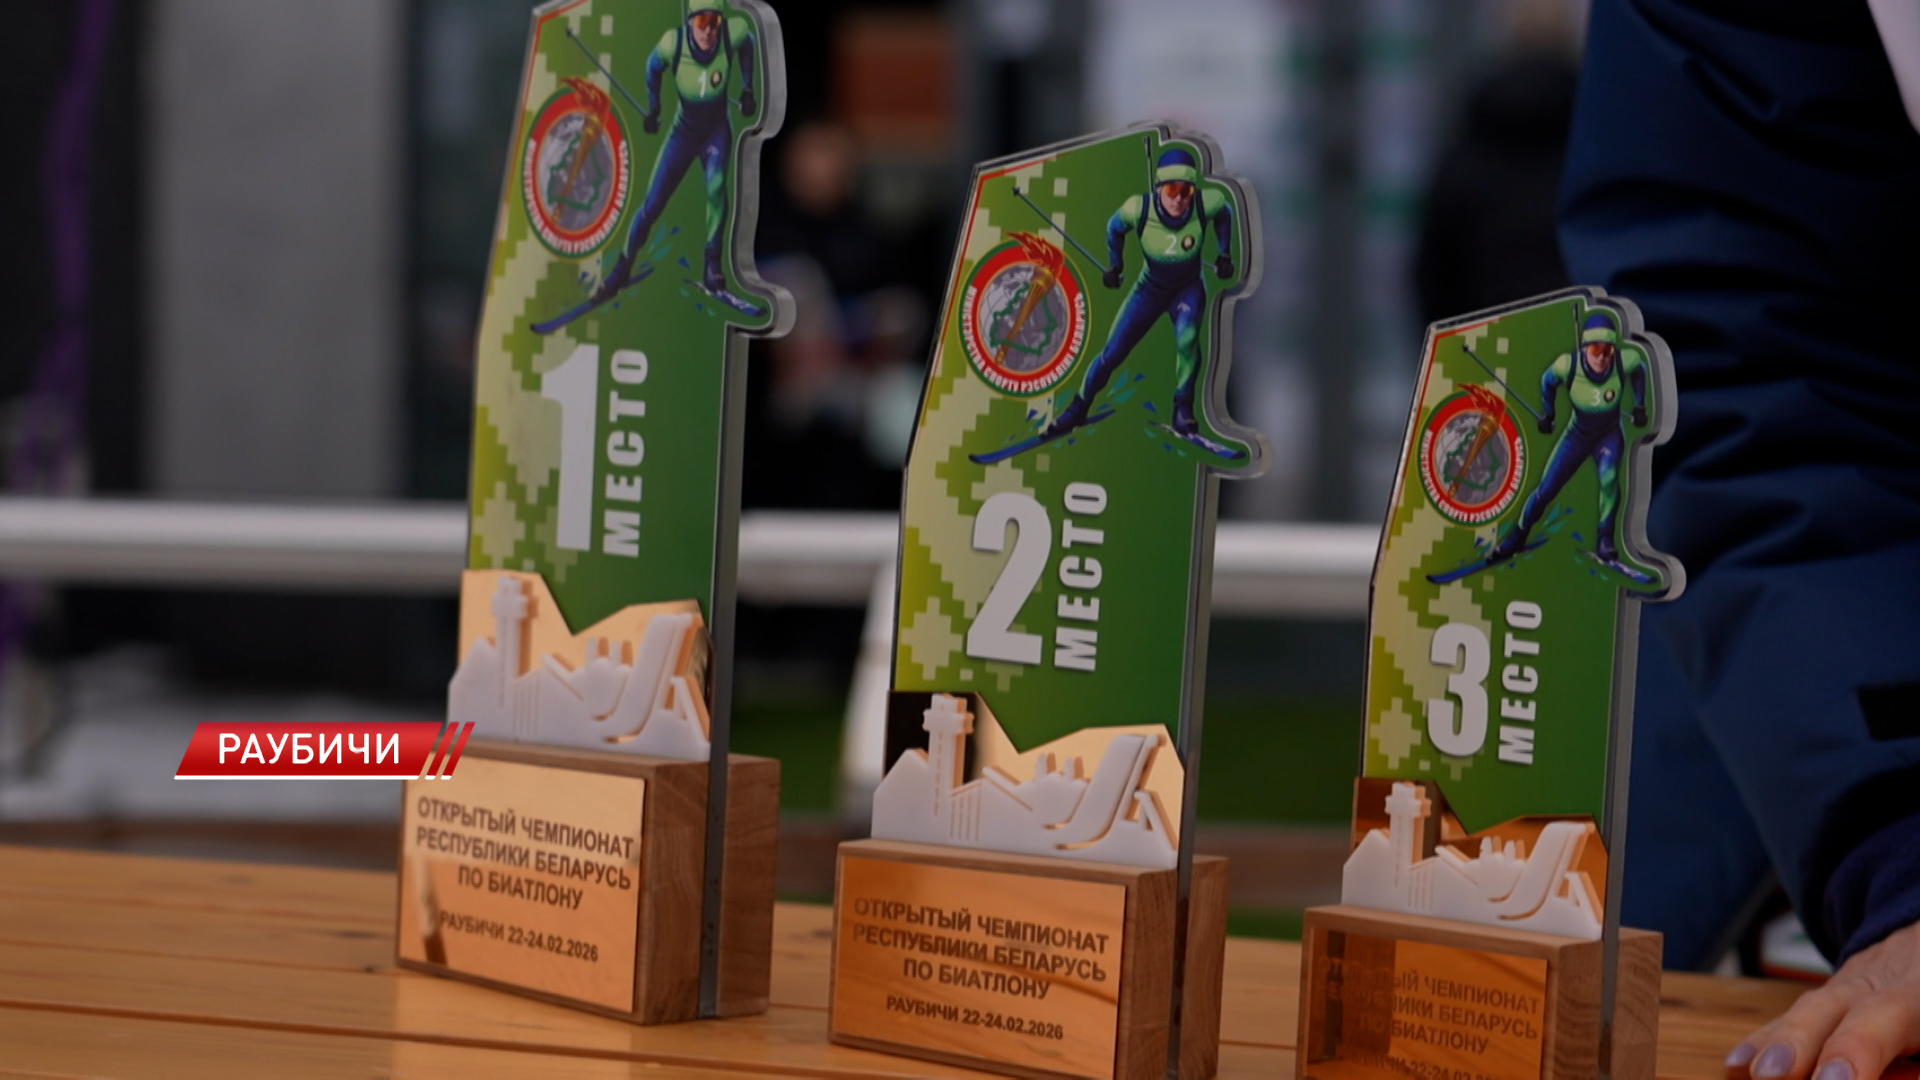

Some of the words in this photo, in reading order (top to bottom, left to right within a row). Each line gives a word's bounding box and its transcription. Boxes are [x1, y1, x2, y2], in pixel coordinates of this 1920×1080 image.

[698, 70, 707, 98] 1
[1164, 235, 1177, 255] 2
[1590, 389, 1600, 406] 3
[541, 343, 599, 551] 1
[603, 349, 648, 557] МЕСТО
[966, 491, 1052, 665] 2
[1054, 481, 1107, 672] МЕСТО
[1427, 623, 1491, 757] 3
[1498, 600, 1542, 765] МЕСТО
[417, 796, 516, 835] ОТКРЫТЫЙ
[521, 817, 634, 859] ЧЕМПИОНАТ
[417, 826, 530, 869] РЕСПУБЛИКИ
[535, 850, 631, 890] БЕЛАРУСЬ
[458, 865, 483, 888] ПО
[488, 872, 583, 910] БИАТЛОНУ
[440, 911, 504, 940] РАУБИЧИ
[508, 925, 598, 962] 22-24.02.2026
[854, 898, 971, 932] ОТКРЫТЫЙ
[977, 914, 1109, 954] ЧЕМПИОНАТ
[853, 923, 987, 962] РЕСПУБЛИКИ
[994, 945, 1106, 982] БЕЛАРУСЬ
[903, 958, 933, 980] ПО
[938, 964, 1050, 1000] БИАТЛОНУ
[1424, 975, 1540, 1014] ЧЕМПИОНАТ
[886, 995, 958, 1021] РАУБИЧИ
[962, 1008, 1063, 1040] 22-24.02.2026
[1391, 1020, 1489, 1054] БИАТЛОНУ
[1439, 1005, 1538, 1040] БЕЛАРУСЬ
